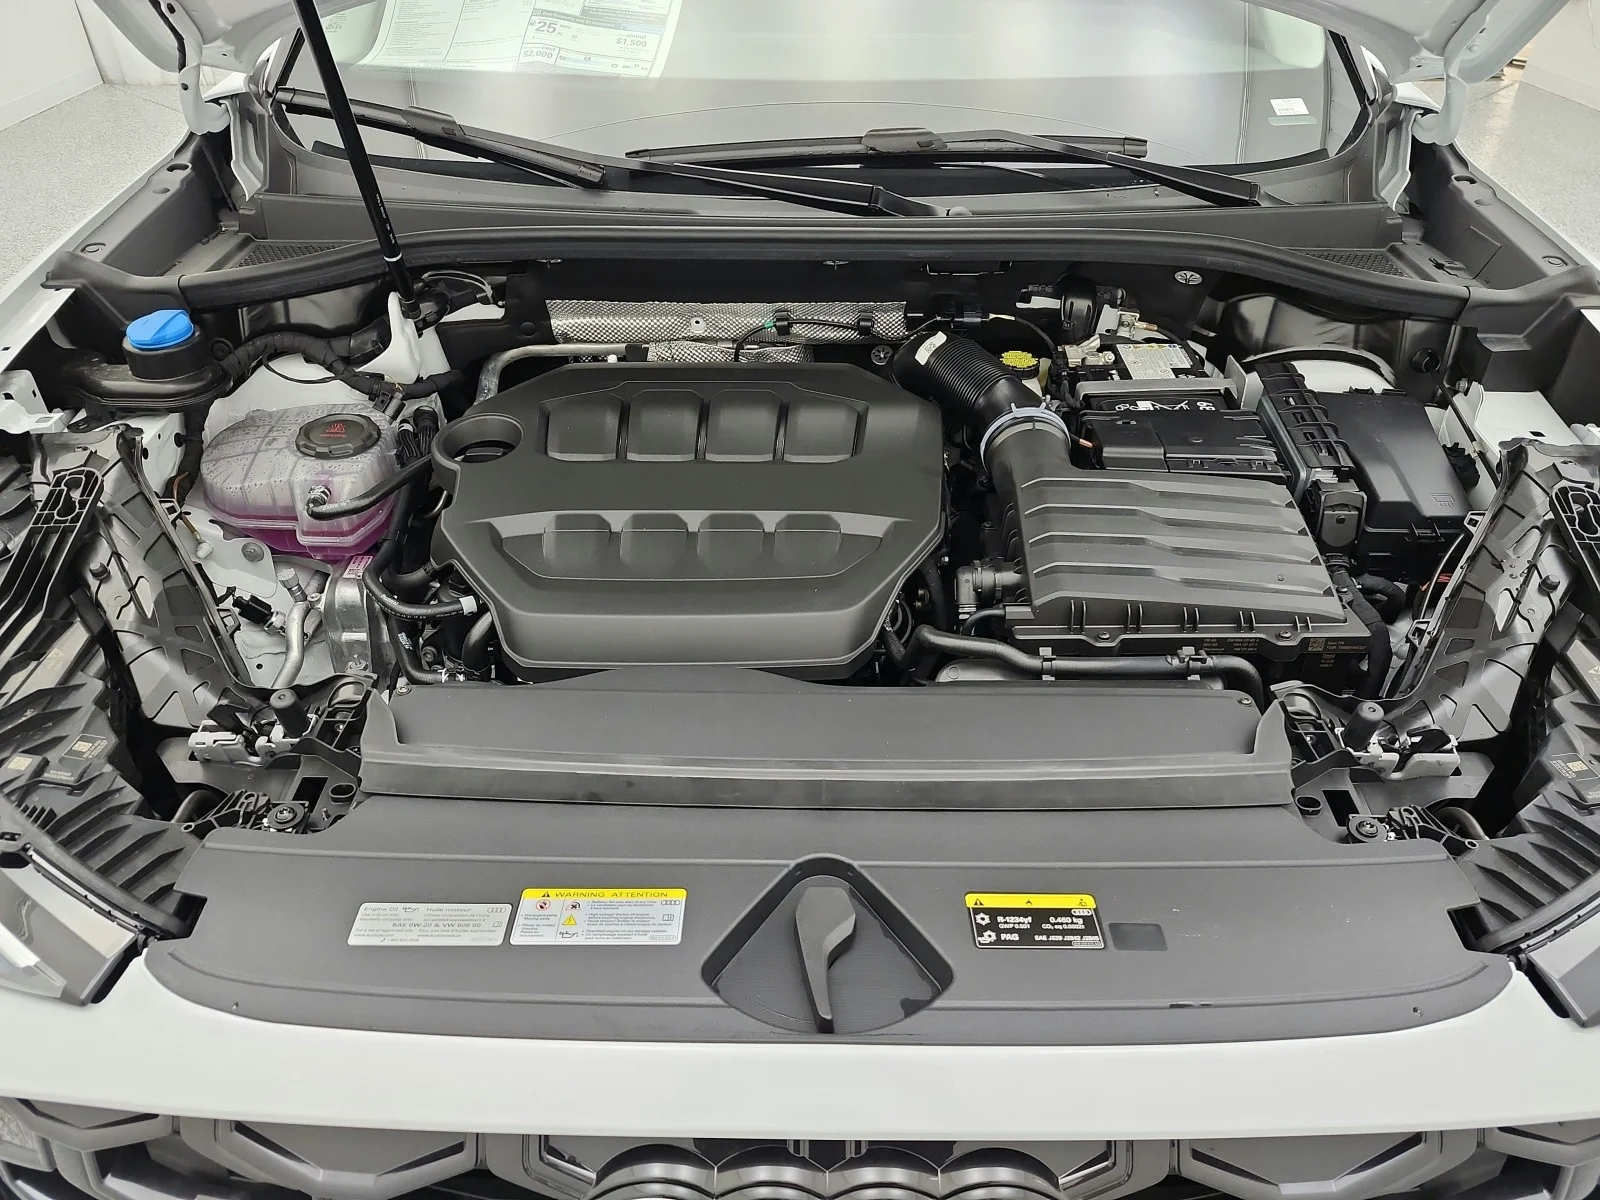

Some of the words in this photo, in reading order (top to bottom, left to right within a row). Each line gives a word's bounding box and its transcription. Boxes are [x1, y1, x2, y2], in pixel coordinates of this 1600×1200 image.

[535, 20, 558, 33] 25
[616, 37, 647, 47] $1,500
[523, 50, 553, 59] $2,000
[997, 916, 1032, 924] R-1234yf
[1000, 933, 1019, 941] PAG
